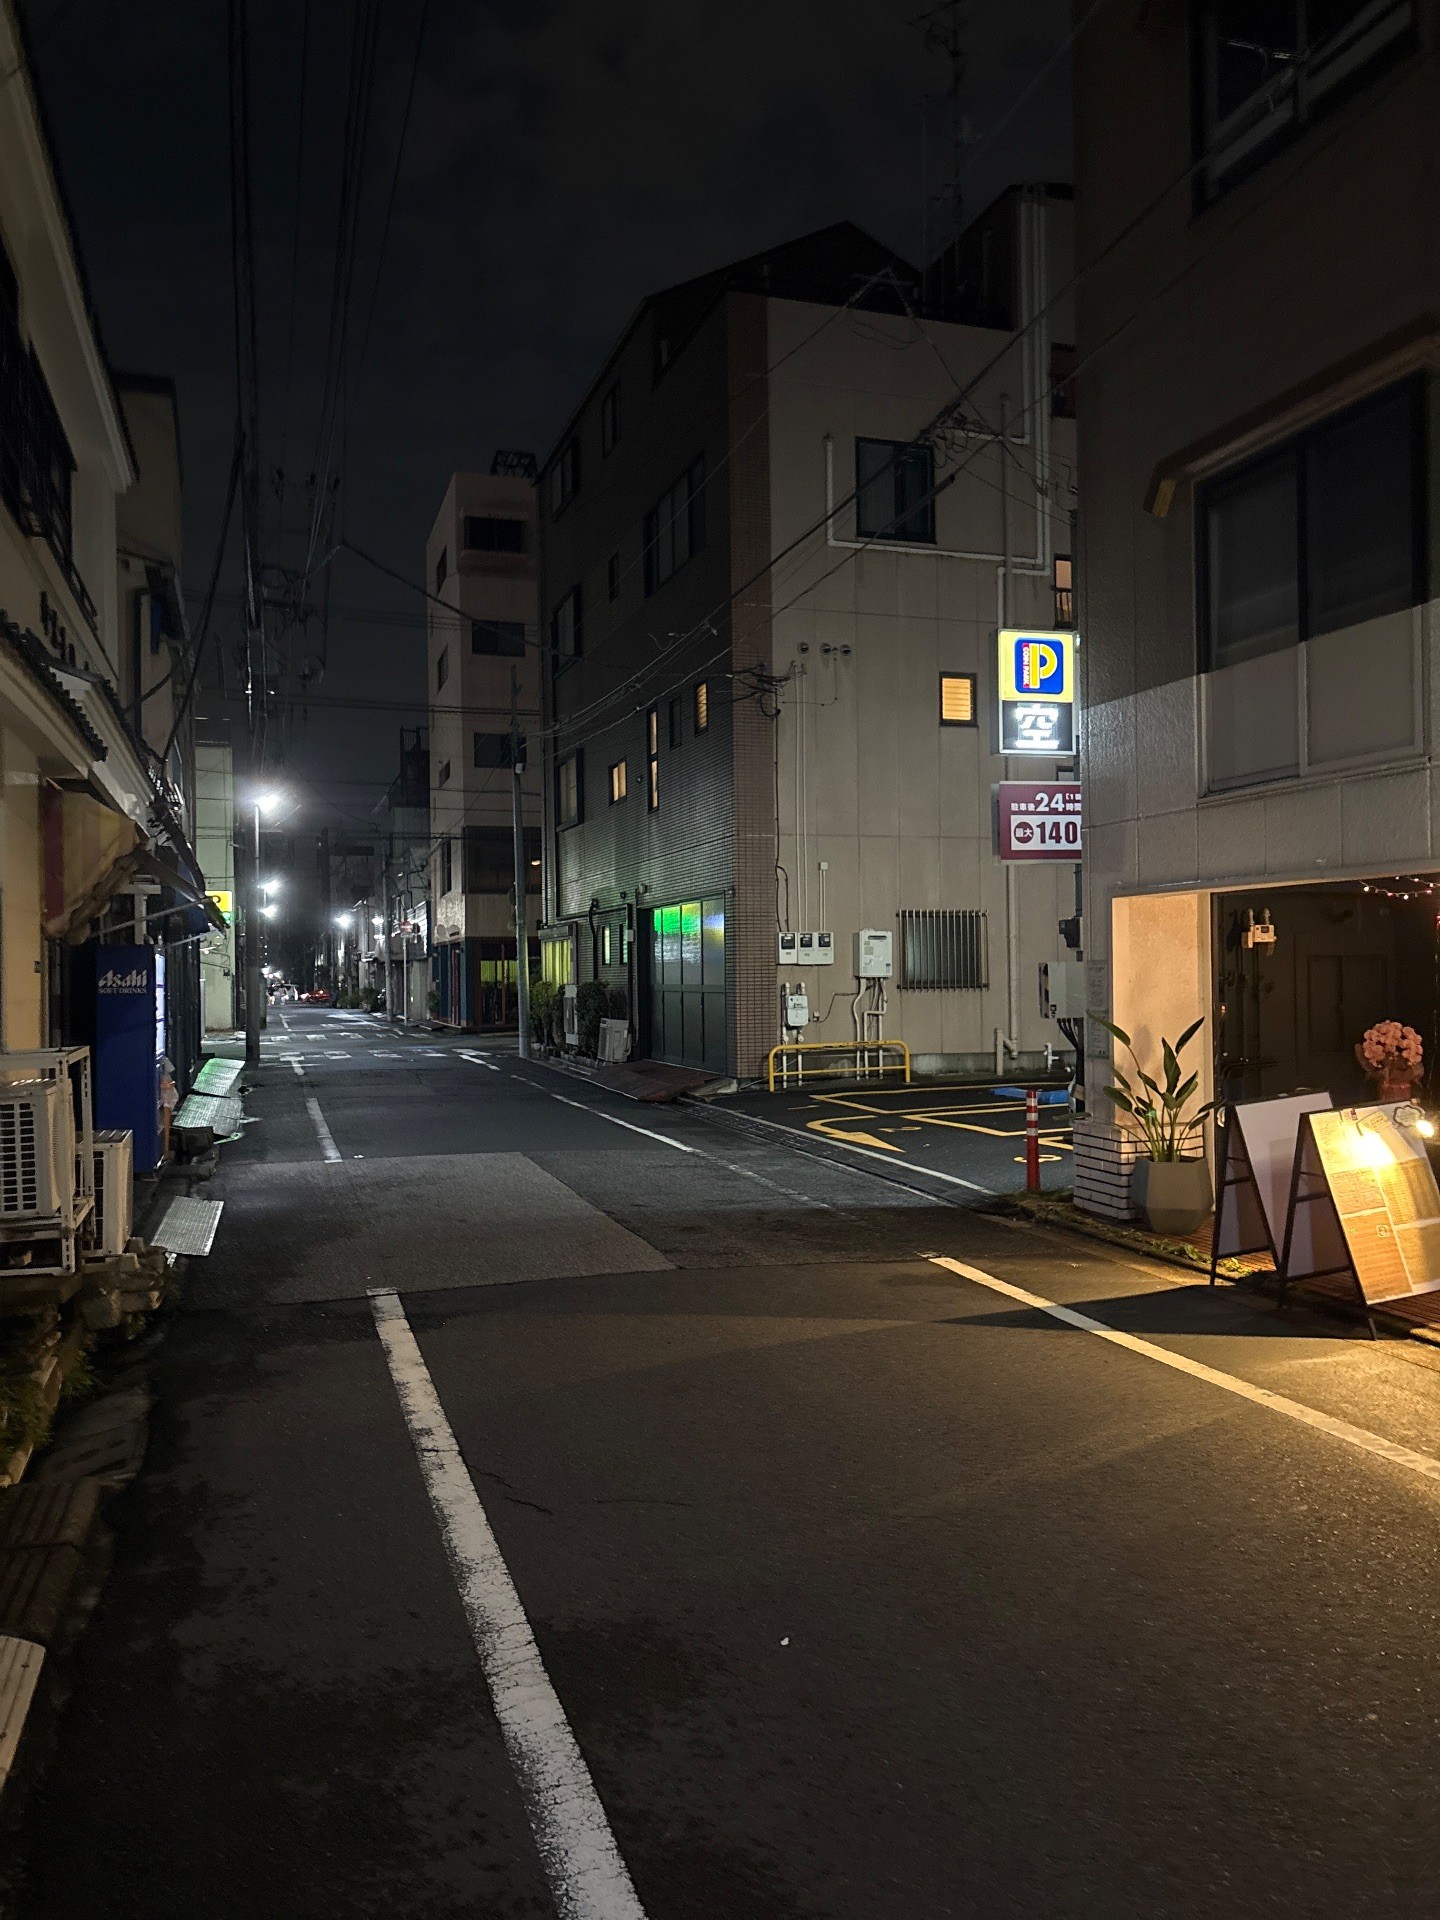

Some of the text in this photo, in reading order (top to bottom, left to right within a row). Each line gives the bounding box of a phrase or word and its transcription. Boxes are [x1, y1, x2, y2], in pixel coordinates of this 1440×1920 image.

[1029, 643, 1058, 689] P
[1014, 703, 1059, 749] 空
[1036, 821, 1082, 844] 140
[98, 969, 147, 987] Asahi
